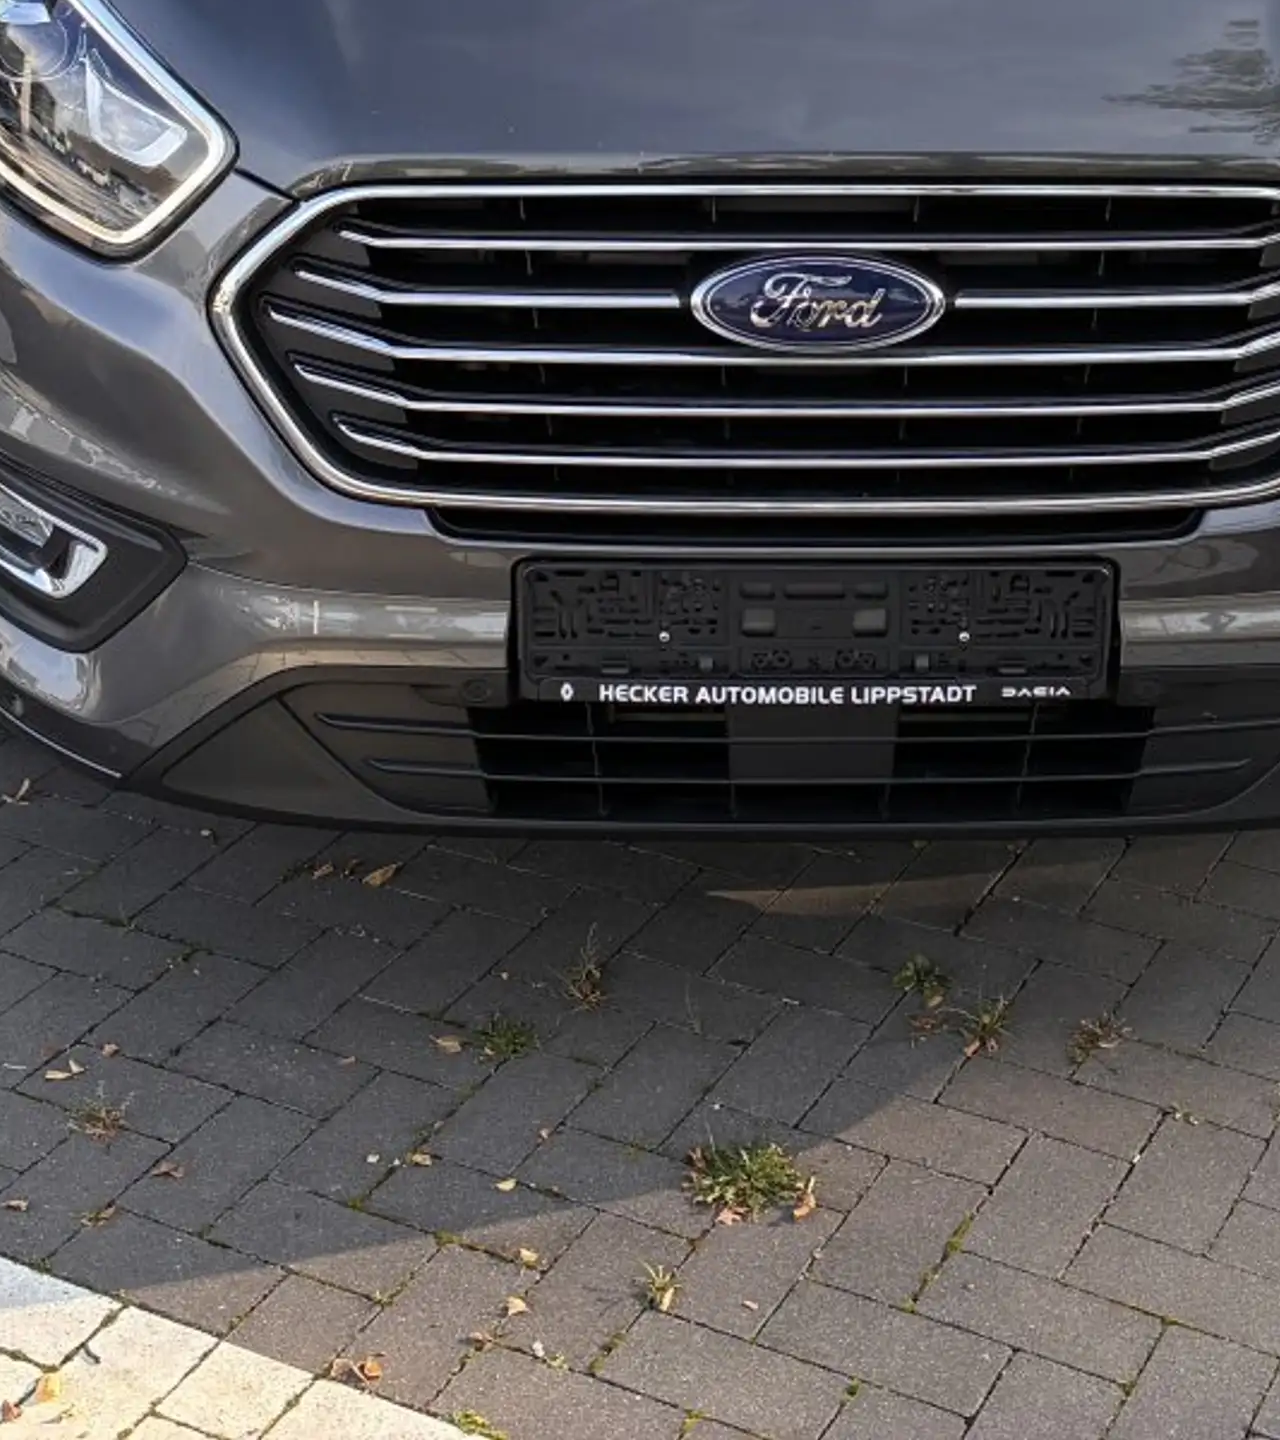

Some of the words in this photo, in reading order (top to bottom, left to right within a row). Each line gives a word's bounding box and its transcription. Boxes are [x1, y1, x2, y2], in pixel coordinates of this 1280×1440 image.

[750, 272, 887, 333] Ford
[598, 683, 690, 704] HECKER
[694, 685, 845, 705] AUTOMOBILE
[851, 684, 977, 705] LIPPSTADT
